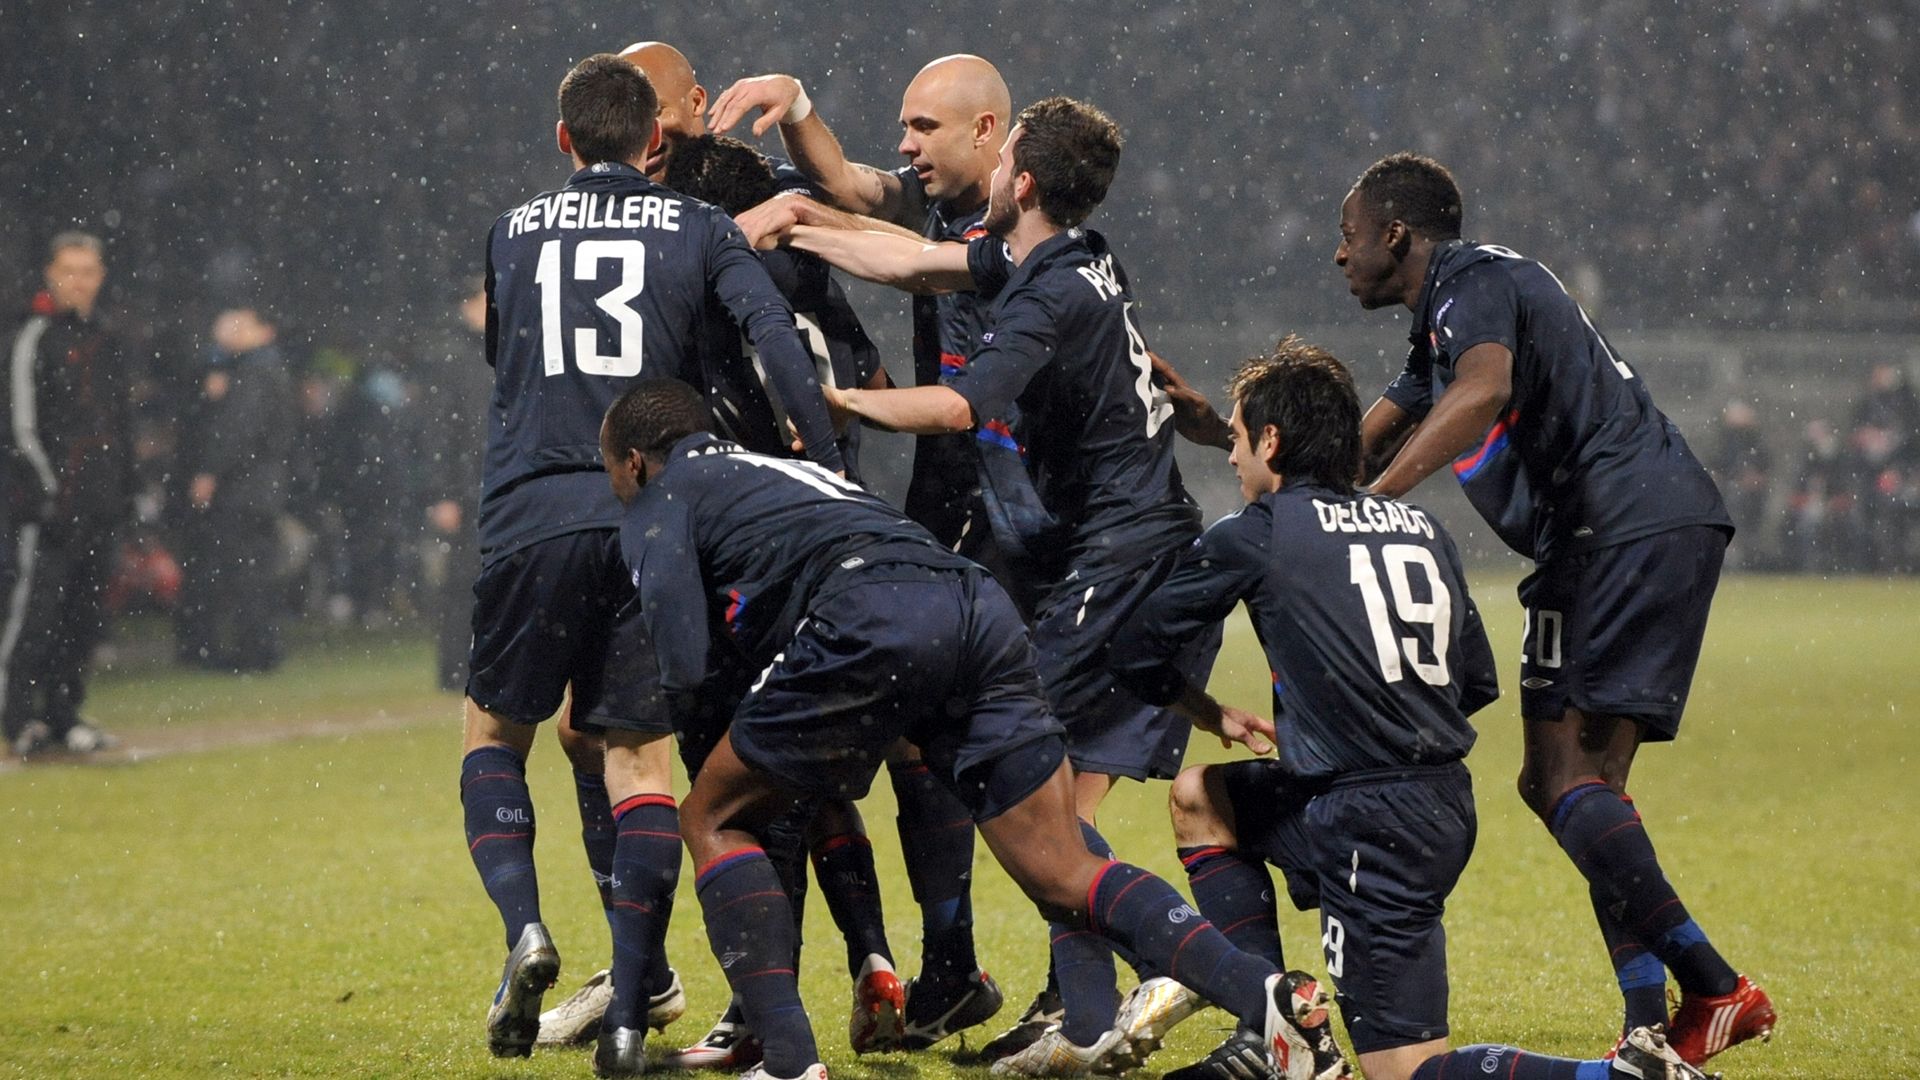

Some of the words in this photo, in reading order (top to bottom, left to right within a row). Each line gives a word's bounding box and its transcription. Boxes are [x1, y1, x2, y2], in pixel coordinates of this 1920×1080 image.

[508, 191, 682, 239] REVEILLERE
[534, 239, 646, 378] 13
[1312, 497, 1435, 540] DELGADO
[1348, 543, 1451, 687] 19
[496, 806, 530, 823] OL
[1167, 904, 1202, 924] OL
[1481, 1046, 1509, 1074] OL
